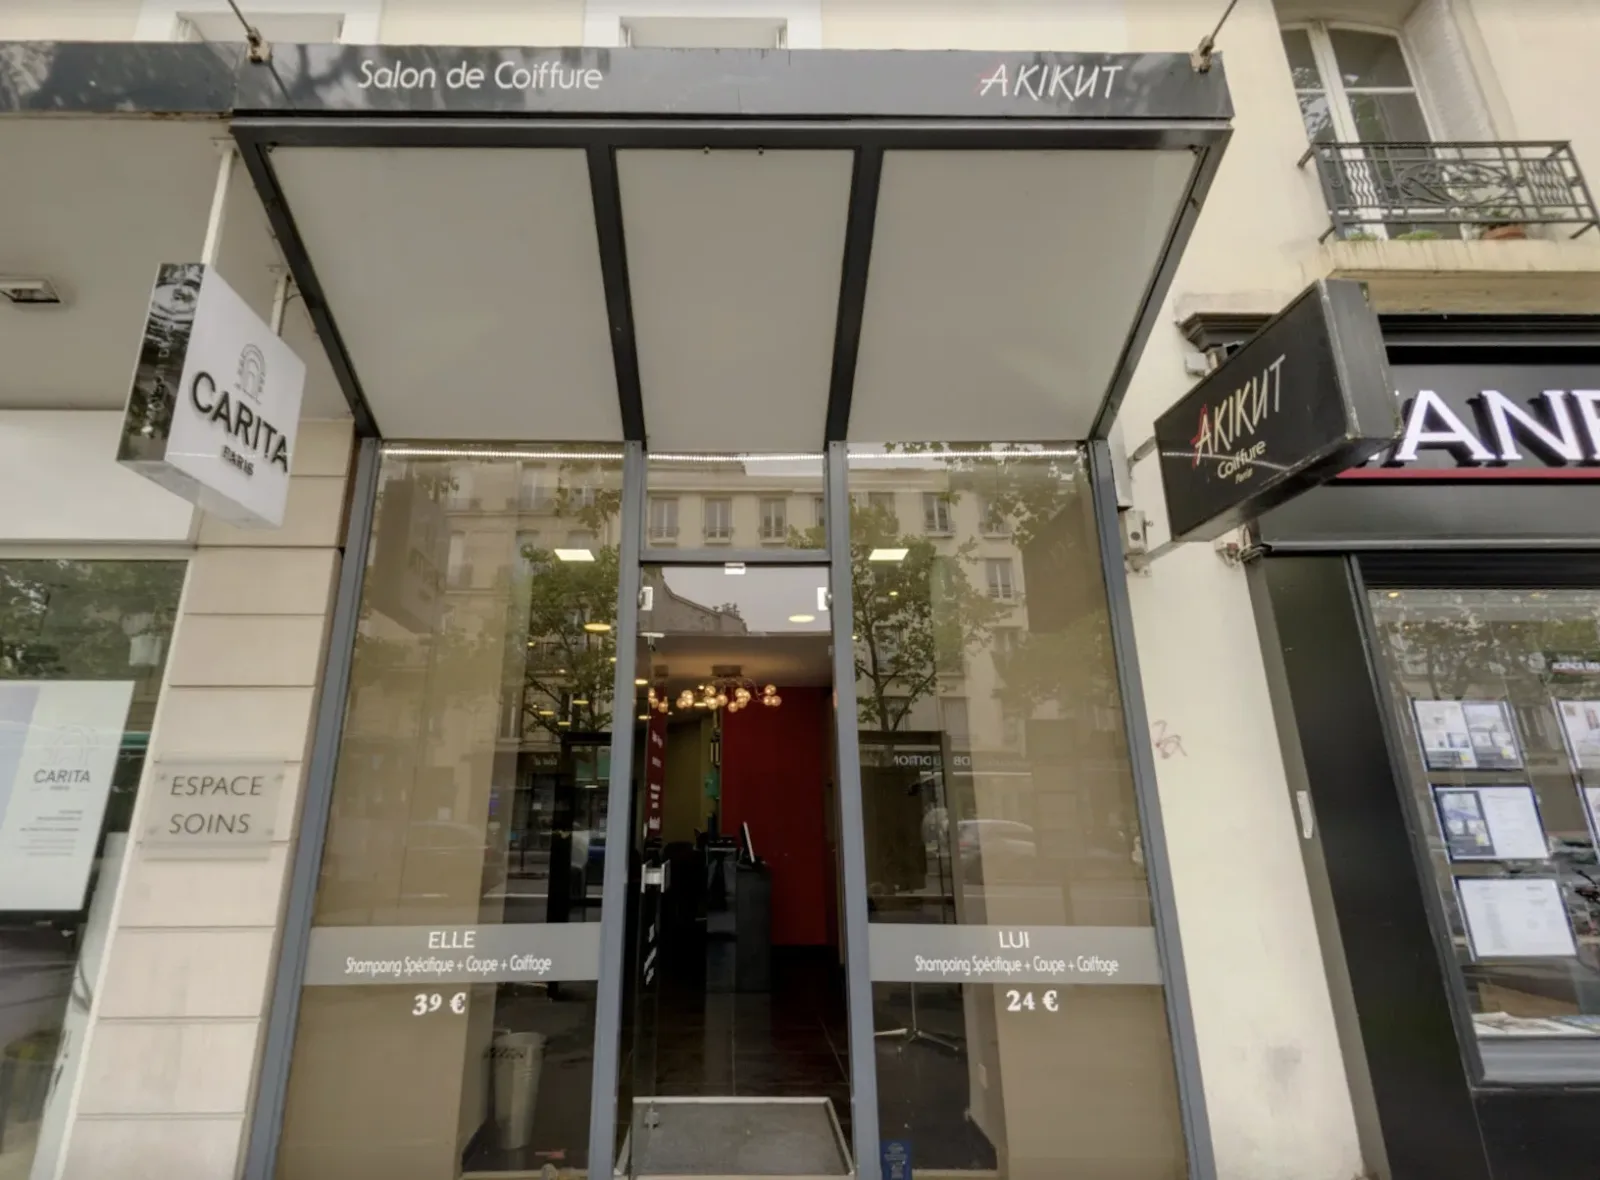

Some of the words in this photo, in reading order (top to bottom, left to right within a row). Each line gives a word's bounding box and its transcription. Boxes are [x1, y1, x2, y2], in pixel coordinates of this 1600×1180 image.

[358, 60, 436, 89] Salon
[446, 61, 484, 89] de
[494, 60, 603, 89] Coiffure
[978, 63, 1124, 102] AKIKUT
[190, 371, 289, 474] CARITA
[1190, 353, 1286, 470] AKIKUT
[1217, 440, 1267, 479] Coiffure
[33, 768, 91, 783] CARITA
[170, 775, 265, 796] ESPACE
[168, 813, 251, 835] SOINS
[428, 930, 477, 949] ELLE
[998, 931, 1030, 949] LUI
[466, 955, 499, 976] Coupe
[510, 954, 553, 976] Coiffage
[914, 955, 971, 976] Shampoing
[1033, 955, 1066, 976] Coupe
[412, 993, 442, 1016] 39
[449, 992, 467, 1014] €
[1006, 990, 1035, 1012] 24
[1042, 990, 1059, 1012] €
